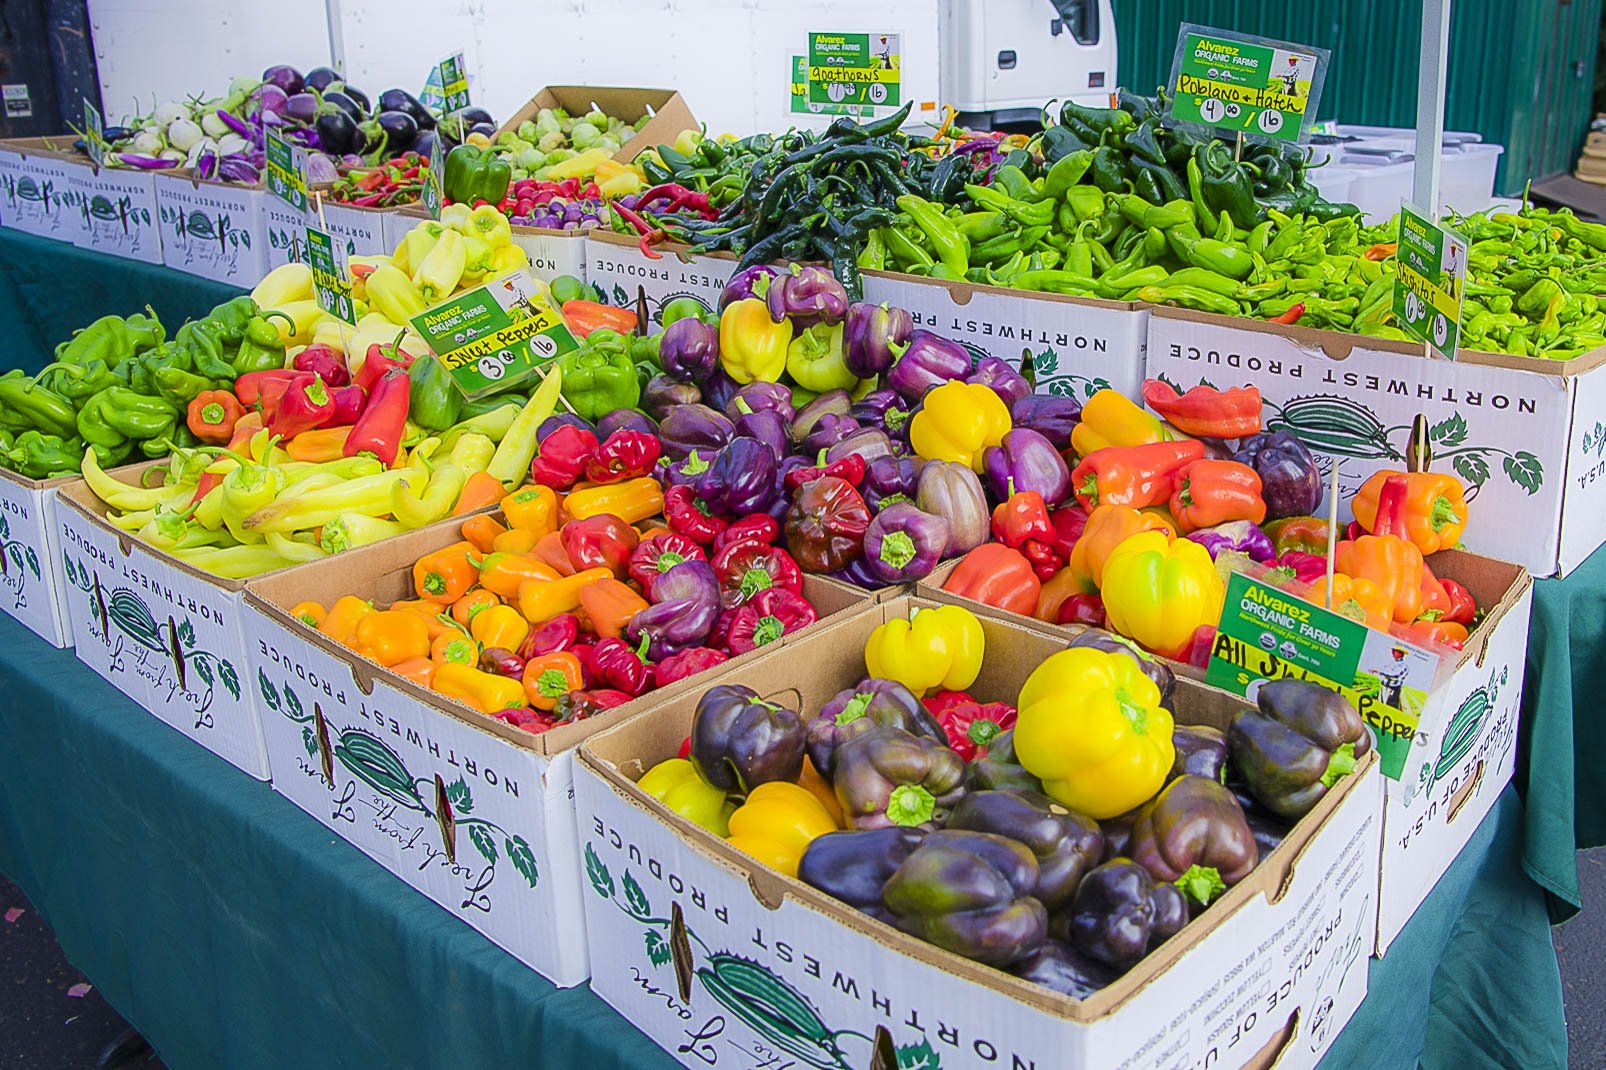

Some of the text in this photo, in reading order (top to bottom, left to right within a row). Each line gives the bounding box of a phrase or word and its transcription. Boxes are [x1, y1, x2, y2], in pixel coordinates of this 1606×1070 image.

[815, 34, 846, 44] Alvarez
[815, 43, 841, 52] ORGANIC
[1197, 39, 1240, 56] Alvarez
[1194, 49, 1231, 64] ORGANIC
[1232, 56, 1259, 68] FARMS
[1255, 88, 1303, 113] Hatch
[1405, 215, 1427, 239] Alvarez
[597, 259, 669, 282] PRODUCE
[423, 304, 464, 327] Alvarez
[428, 315, 462, 336] ORGANIC
[462, 304, 488, 322] FARMS
[950, 317, 1108, 353] NORTHWEST
[1169, 343, 1304, 379] PRODUCE
[1321, 368, 1537, 414] NORTHWEST
[63, 523, 225, 627] NORTHWEST PRODUCE
[1243, 585, 1311, 624] Alvarez
[1240, 598, 1341, 649] ORGANIC FARMS
[1214, 633, 1247, 669] All
[257, 638, 520, 799] NORTHWEST PRODUCE
[1441, 776, 1459, 807] OF
[592, 814, 730, 926] PRODUCE
[1266, 907, 1342, 1015] PRODUCE
[751, 927, 1036, 1070] NORTHWEST
[1228, 1011, 1258, 1051] OF
